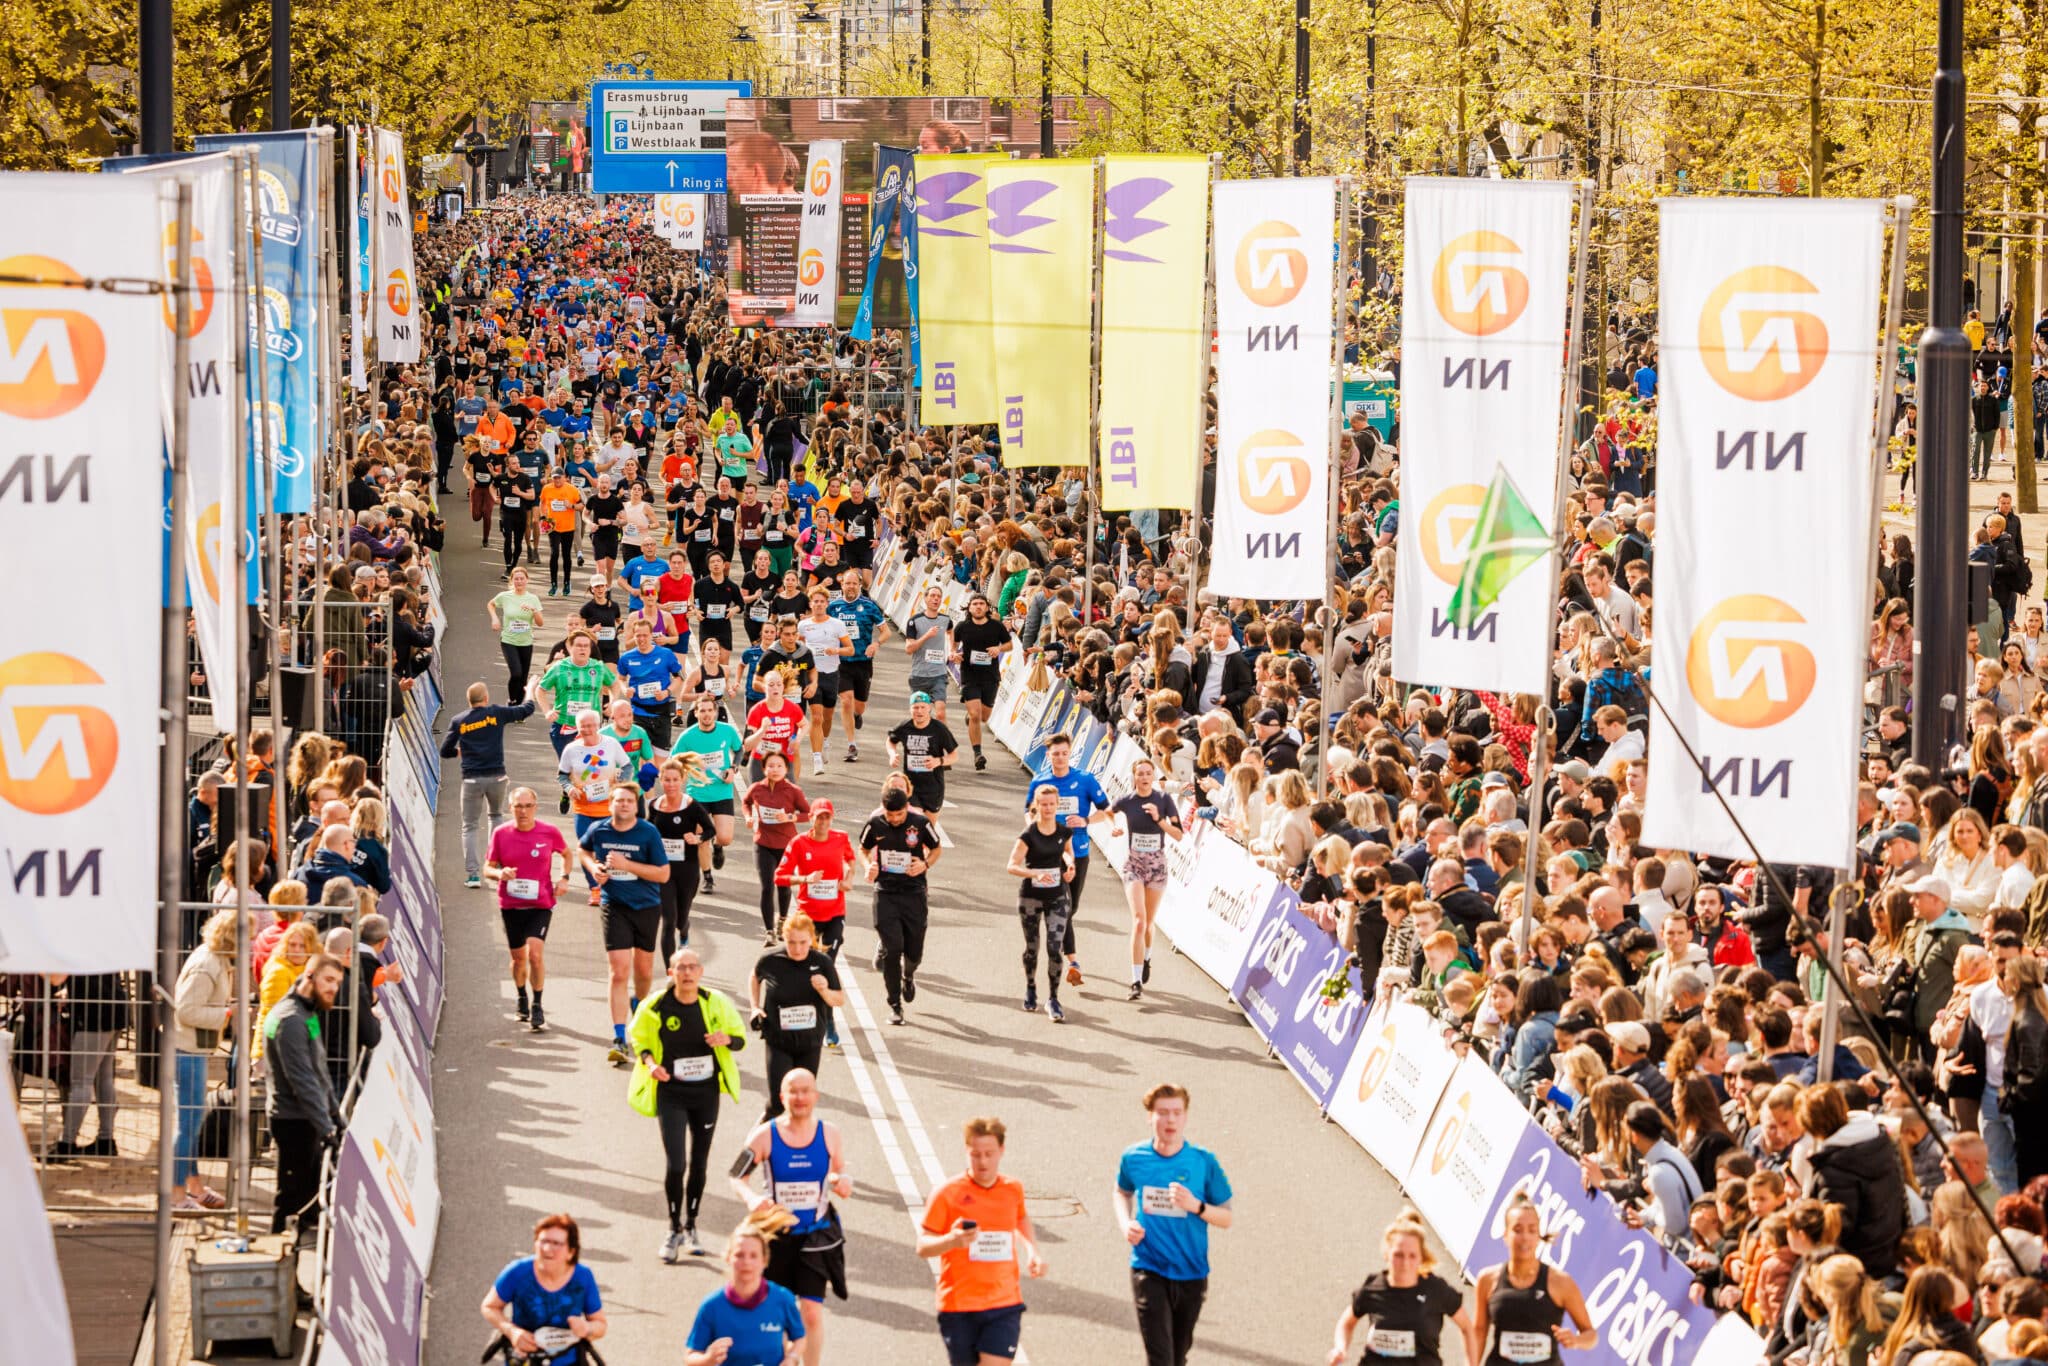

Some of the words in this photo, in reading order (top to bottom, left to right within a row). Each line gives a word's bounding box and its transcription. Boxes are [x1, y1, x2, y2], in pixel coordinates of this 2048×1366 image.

[607, 92, 688, 104] Erasmusbrug
[653, 106, 705, 119] Lijnbaan
[631, 120, 684, 132] Lijnbaan
[631, 137, 696, 148] Westblaak
[682, 177, 711, 190] Ring
